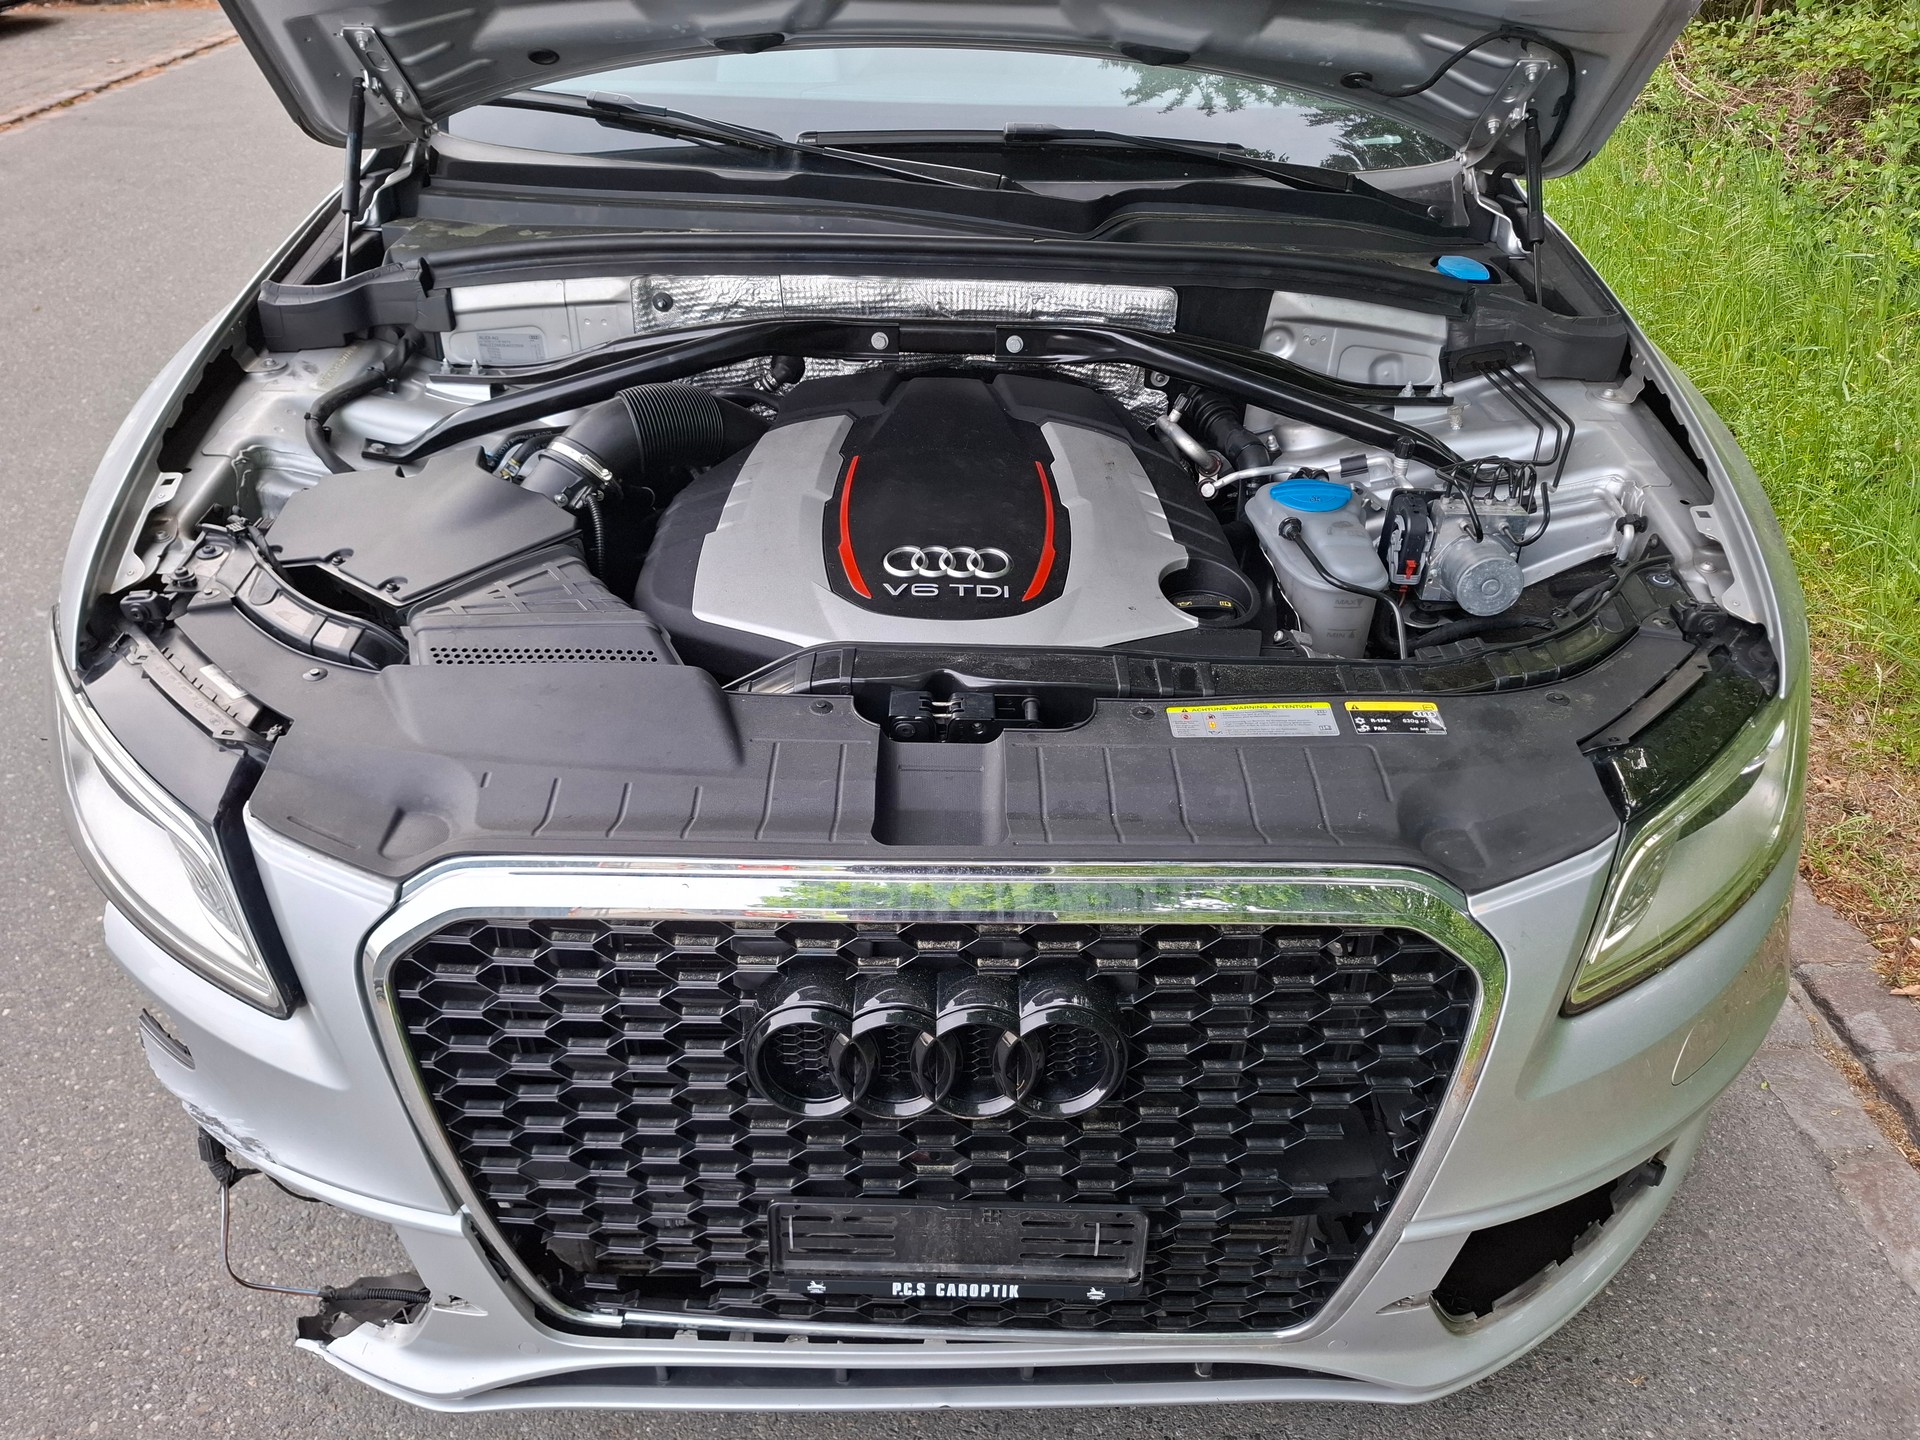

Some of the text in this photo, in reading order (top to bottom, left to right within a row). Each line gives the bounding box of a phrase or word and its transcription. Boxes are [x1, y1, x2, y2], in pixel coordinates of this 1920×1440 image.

[882, 583, 1010, 598] V6 TDI
[935, 1283, 1020, 1299] CAROPTIK
